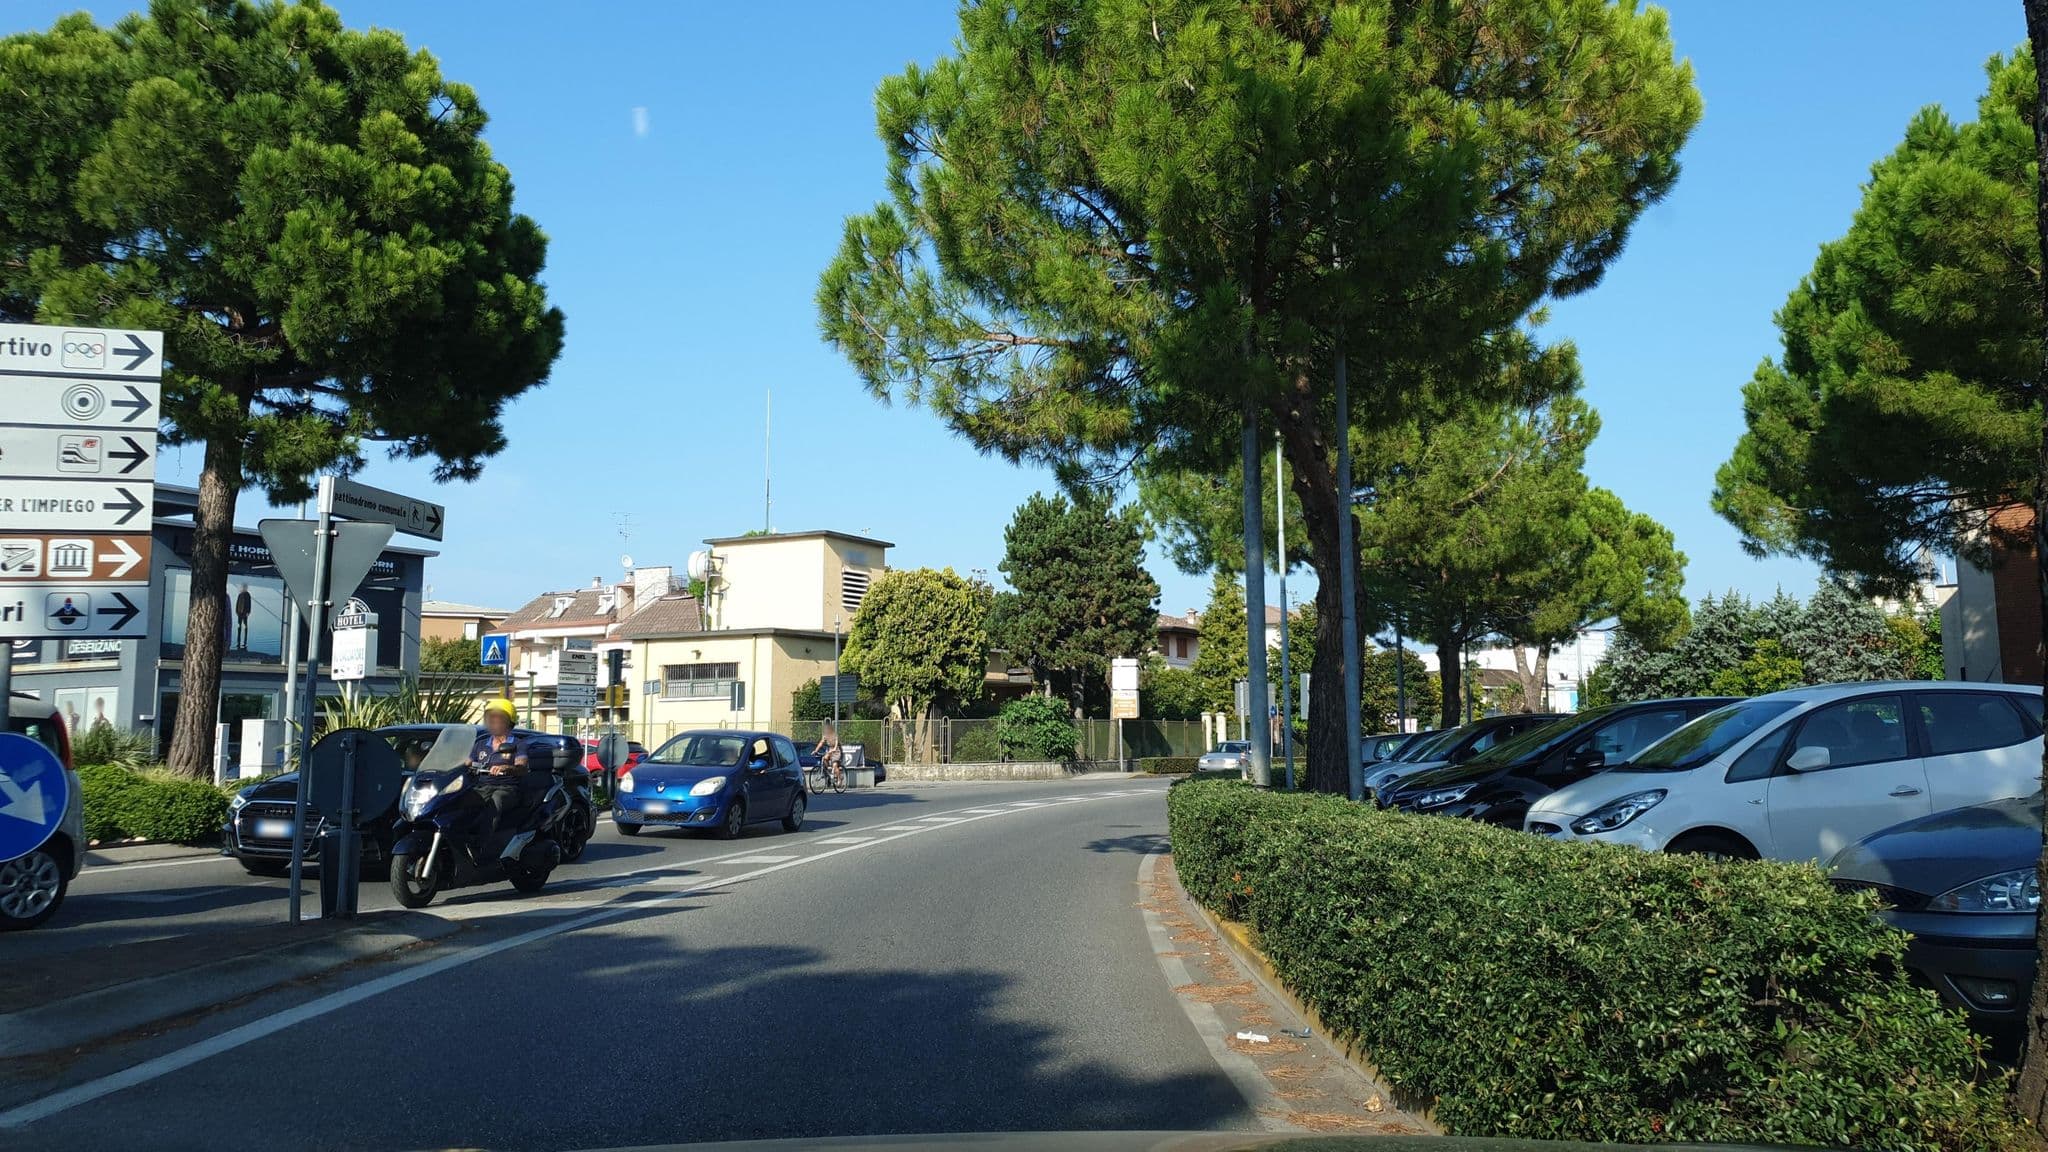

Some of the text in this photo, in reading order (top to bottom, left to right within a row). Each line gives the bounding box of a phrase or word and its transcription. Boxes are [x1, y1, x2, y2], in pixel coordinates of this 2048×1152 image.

[22, 498, 95, 512] L'IMPIEGO
[378, 503, 407, 518] comunale
[0, 601, 24, 621] ri
[337, 615, 363, 626] HOTEL
